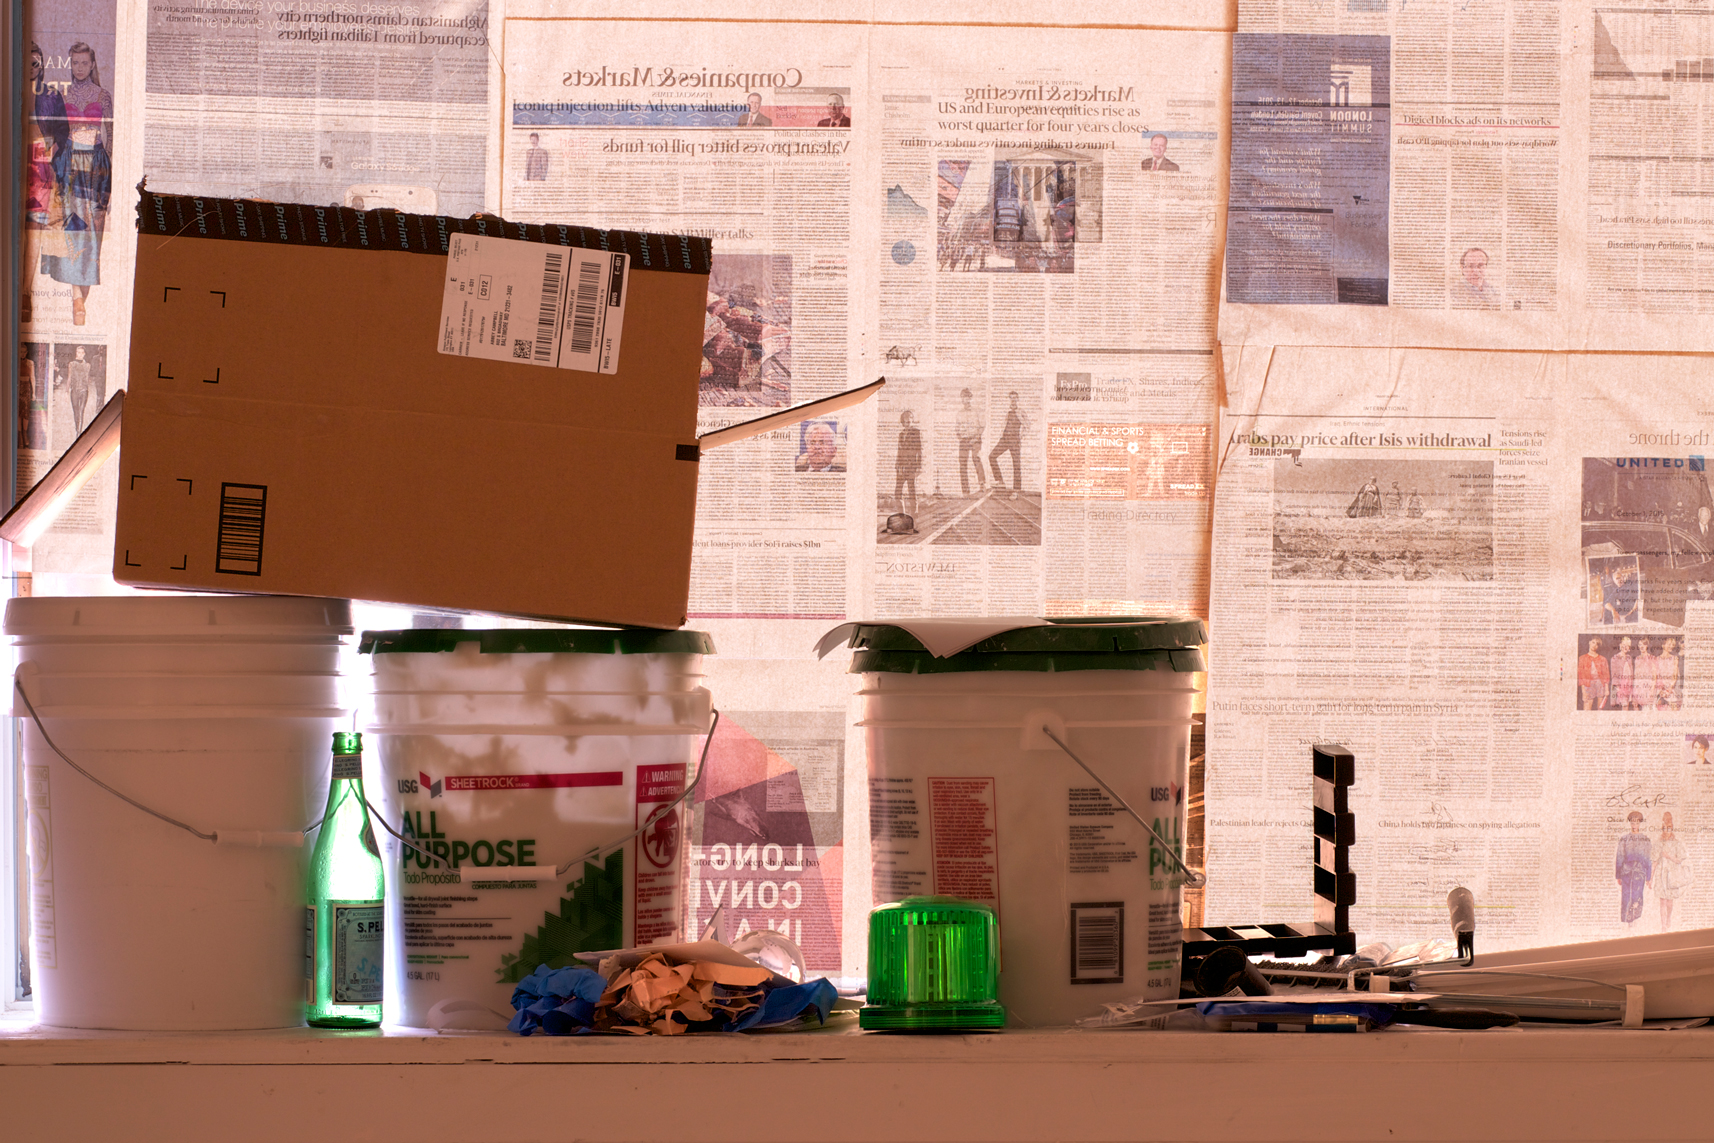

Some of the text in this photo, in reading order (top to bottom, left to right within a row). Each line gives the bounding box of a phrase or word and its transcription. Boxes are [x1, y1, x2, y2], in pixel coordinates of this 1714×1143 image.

[221, 0, 420, 16] device your business deserves
[193, 14, 217, 28] The
[268, 21, 297, 33] your
[300, 22, 375, 34] employees
[379, 23, 420, 34] desire
[513, 99, 752, 117] Iconiq injection lifts Adyen valuation
[938, 102, 1141, 119] US and European equities rise as
[938, 119, 1149, 135] worst quarter for four years closes
[1403, 114, 1552, 127] Digicel blocks ads on its networks
[350, 161, 385, 173] Galaxy
[152, 196, 167, 232] Prime
[194, 198, 208, 235] Prime
[234, 201, 248, 238] Prime
[274, 204, 288, 241] Prime
[314, 207, 329, 243] Prime
[354, 210, 369, 246] Prime
[395, 213, 409, 249] Prime
[435, 216, 450, 251] Prime
[638, 231, 652, 267] Prime
[678, 235, 692, 270] Prime
[727, 228, 754, 239] talks
[1607, 240, 1695, 251] Discretionary Portfolios,
[480, 279, 490, 297] C012
[500, 312, 511, 347] BALTIMORE MD
[1138, 377, 1170, 388] Shares,
[1129, 388, 1146, 398] and
[1051, 426, 1145, 436] FINANCIAL & SPORTS
[1500, 429, 1548, 438] Tensions rise
[1050, 437, 1125, 447] SPREAD BETTING
[1270, 431, 1492, 449] pay price after Isis withdrawal
[1508, 438, 1543, 448] Saudi-led
[1521, 449, 1541, 457] seize
[1498, 457, 1549, 466] Iranian vessel
[1616, 457, 1684, 468] UNITED
[1081, 508, 1177, 523] Trading Directory
[710, 539, 731, 549] loans
[730, 539, 763, 549] provider
[763, 539, 781, 549] SoFi
[781, 540, 803, 549] raises
[1211, 700, 1238, 711] Putin
[1238, 700, 1263, 711] faces
[1263, 700, 1316, 712] short-term
[1433, 702, 1459, 716] Syria
[651, 769, 684, 783] WARNING
[397, 779, 419, 794] USG
[450, 777, 515, 789] SHEETROCK
[1150, 786, 1170, 802] USG
[401, 810, 446, 839] ALL
[1209, 818, 1300, 829] Palestinian leader rejects
[1377, 820, 1401, 829] China
[1400, 820, 1422, 829] holds
[1478, 821, 1503, 831] spying
[1503, 820, 1541, 830] allegations
[1149, 816, 1181, 846] ALL
[401, 839, 537, 869] PURPOSE
[717, 857, 821, 870] try to keep sharks at bay
[403, 871, 462, 886] Todo Propósito
